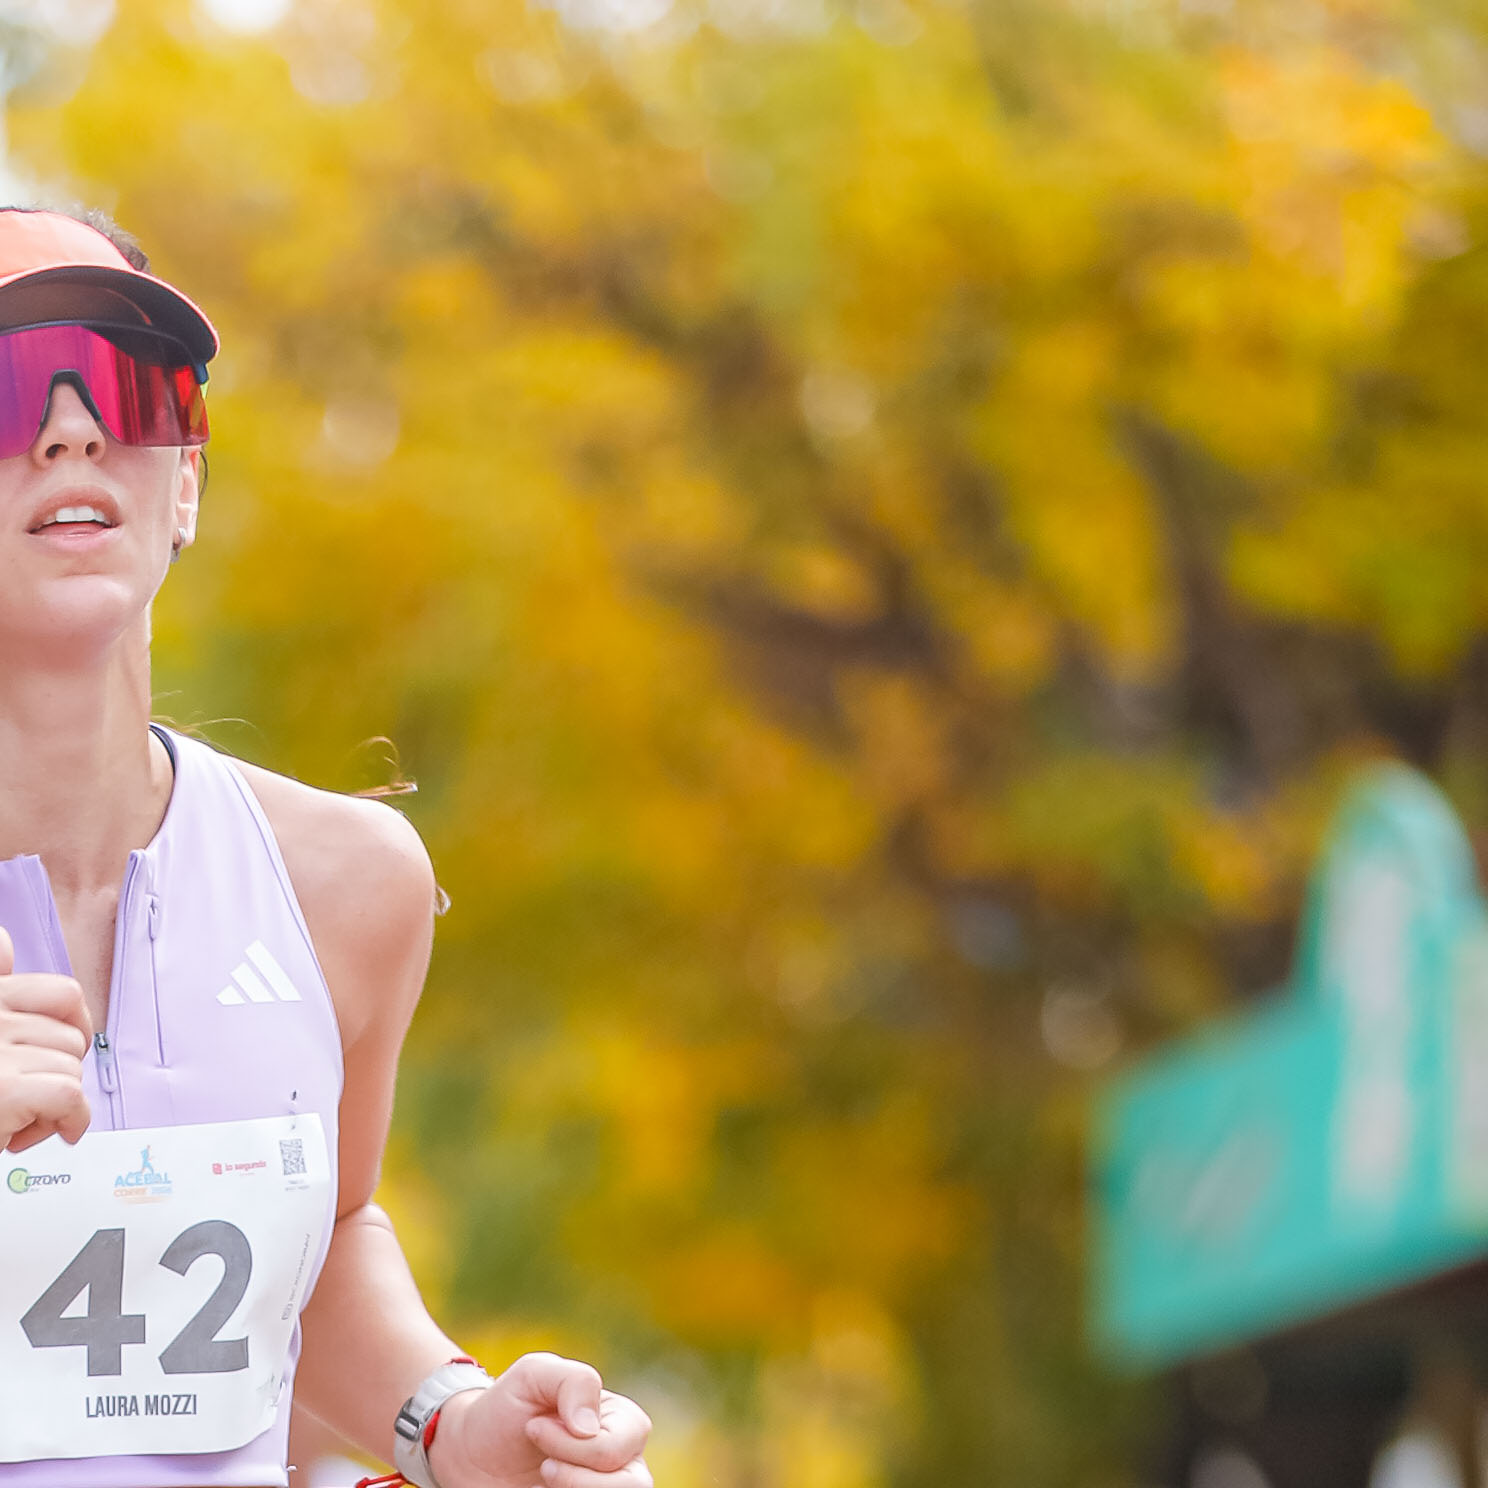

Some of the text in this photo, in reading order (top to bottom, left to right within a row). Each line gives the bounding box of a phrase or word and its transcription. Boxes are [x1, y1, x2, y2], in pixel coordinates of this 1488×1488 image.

[20, 1220, 252, 1376] 42
[85, 1394, 197, 1418] LAURA MOZZI
